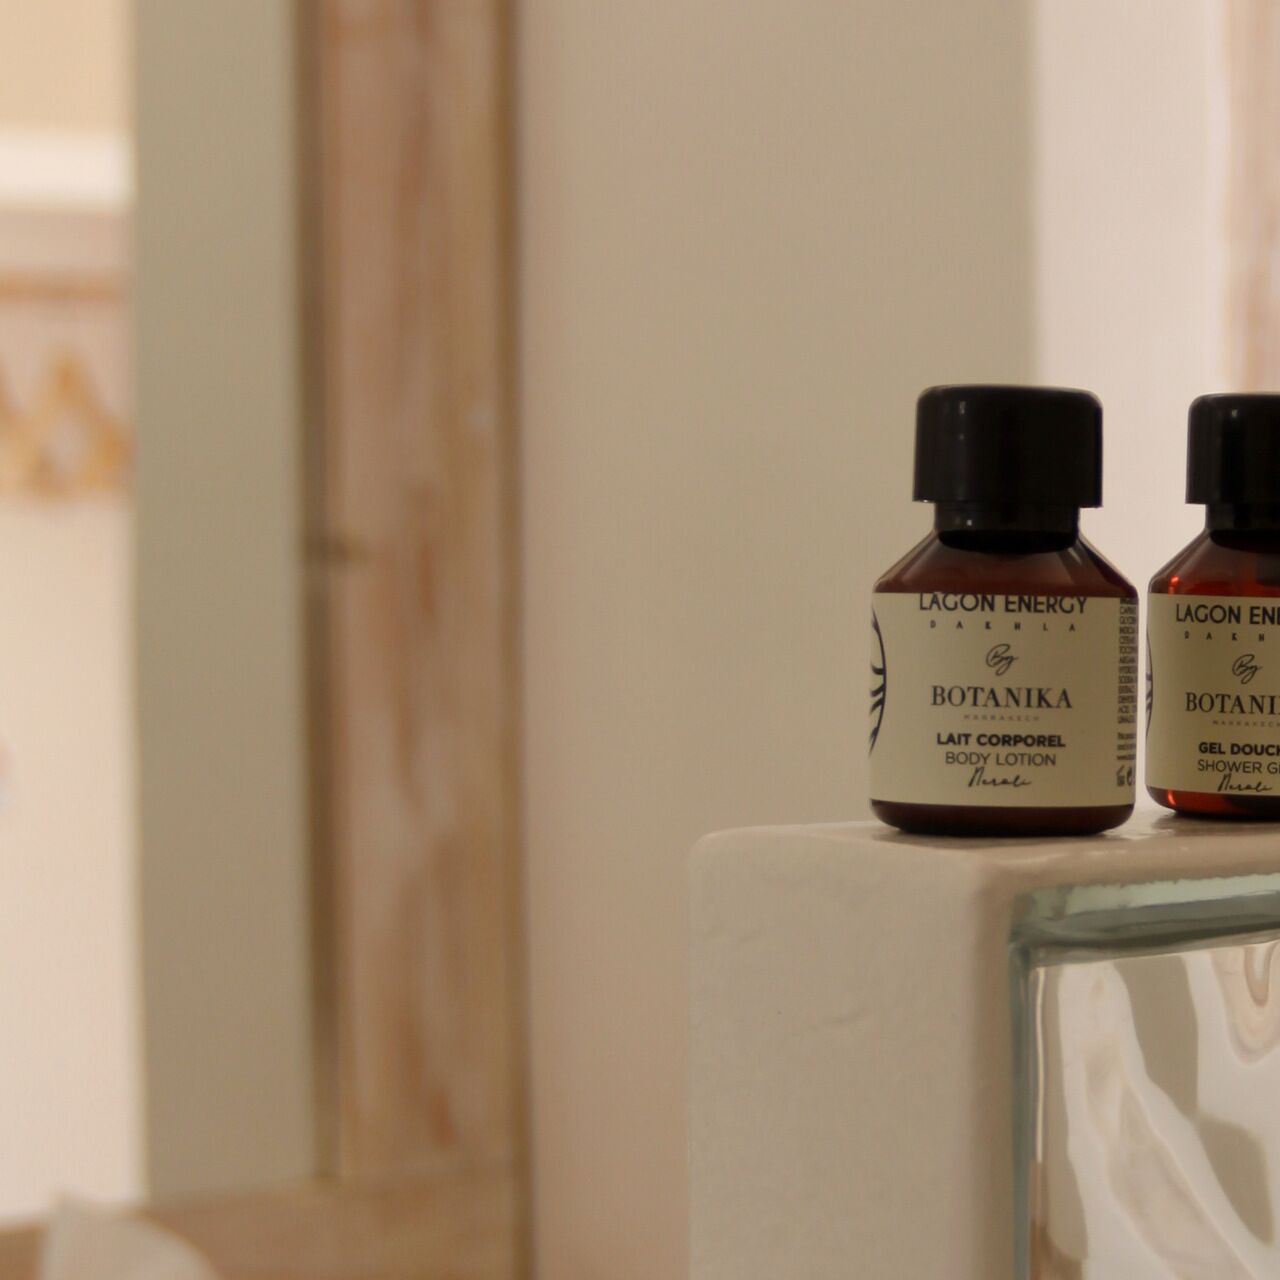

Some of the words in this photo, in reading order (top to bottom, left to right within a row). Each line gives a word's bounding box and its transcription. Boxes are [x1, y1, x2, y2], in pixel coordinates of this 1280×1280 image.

[919, 592, 995, 612] LAGON
[1004, 594, 1089, 614] ENERGY
[1175, 603, 1241, 625] LAGON
[930, 685, 1073, 709] BOTANIKA
[936, 732, 972, 746] LAIT
[976, 733, 1066, 748] CORPOREL
[1198, 742, 1226, 755] GEL
[945, 751, 991, 766] BODY
[996, 752, 1056, 767] LOTION
[1197, 758, 1263, 774] SHOWER
